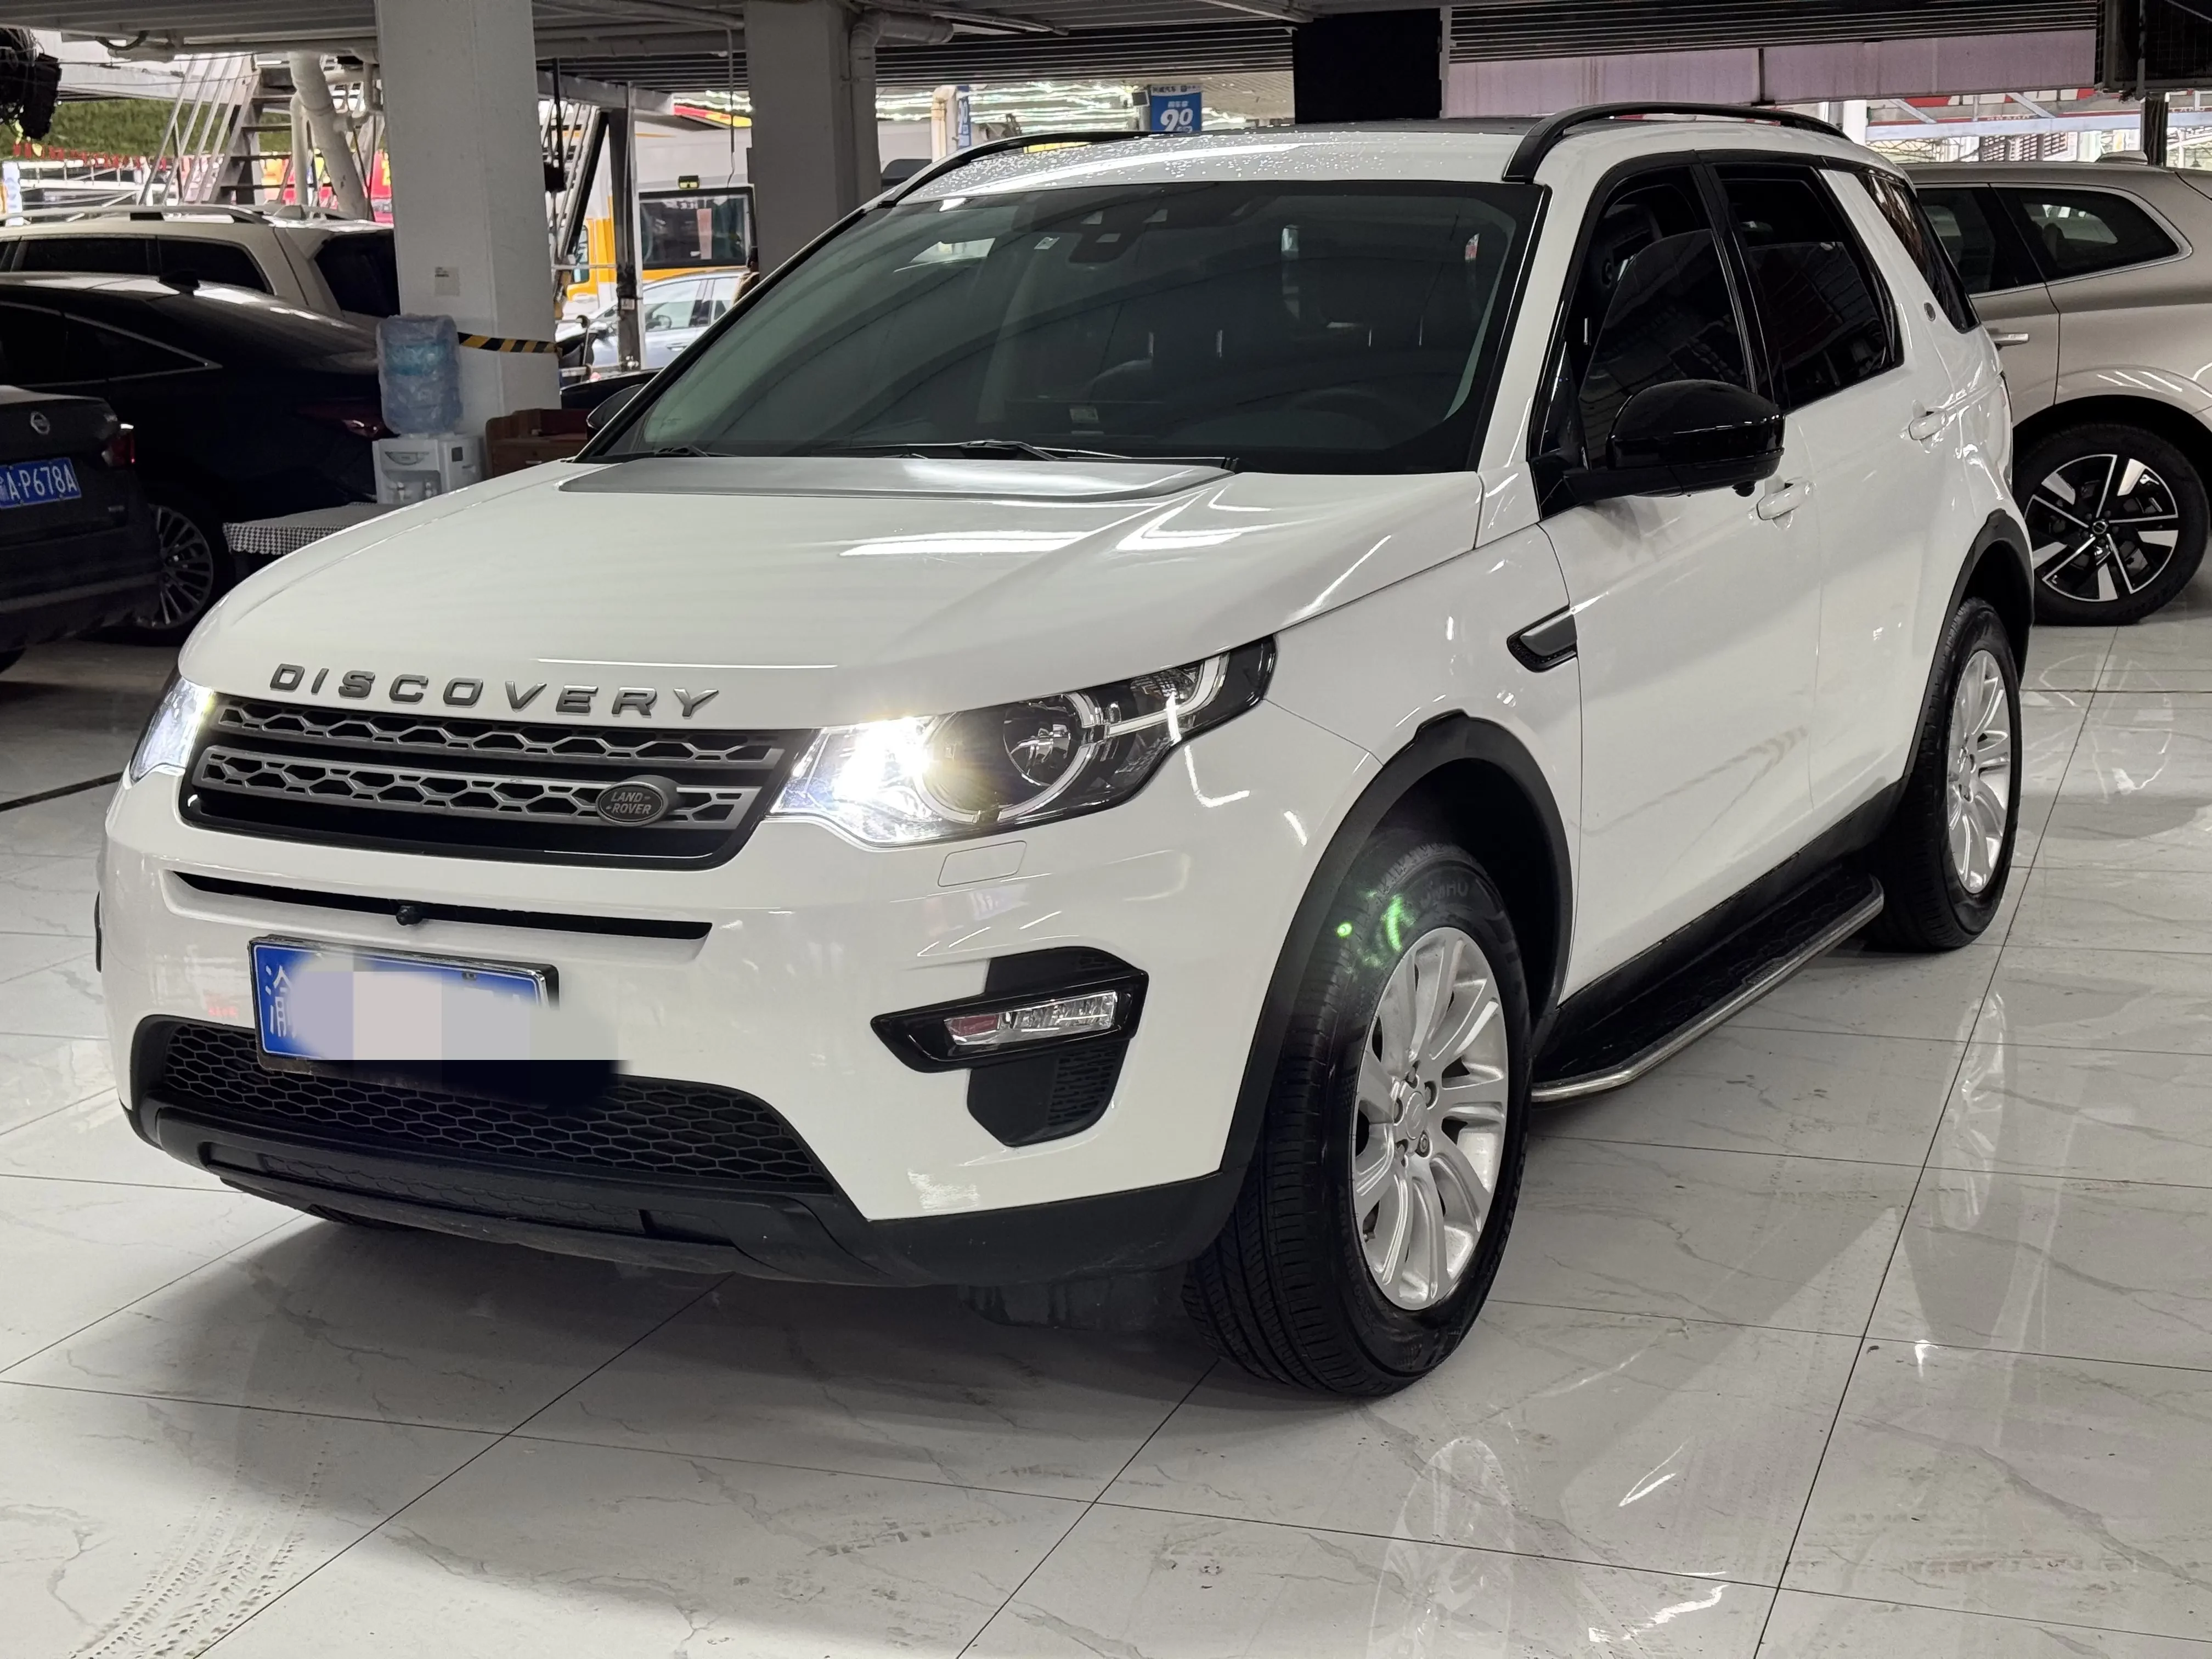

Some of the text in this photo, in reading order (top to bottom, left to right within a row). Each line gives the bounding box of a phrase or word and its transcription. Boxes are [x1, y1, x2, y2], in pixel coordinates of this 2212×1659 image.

[270, 663, 719, 718] DISCOVERY
[611, 791, 644, 803] LAND
[612, 803, 652, 815] ROVER
